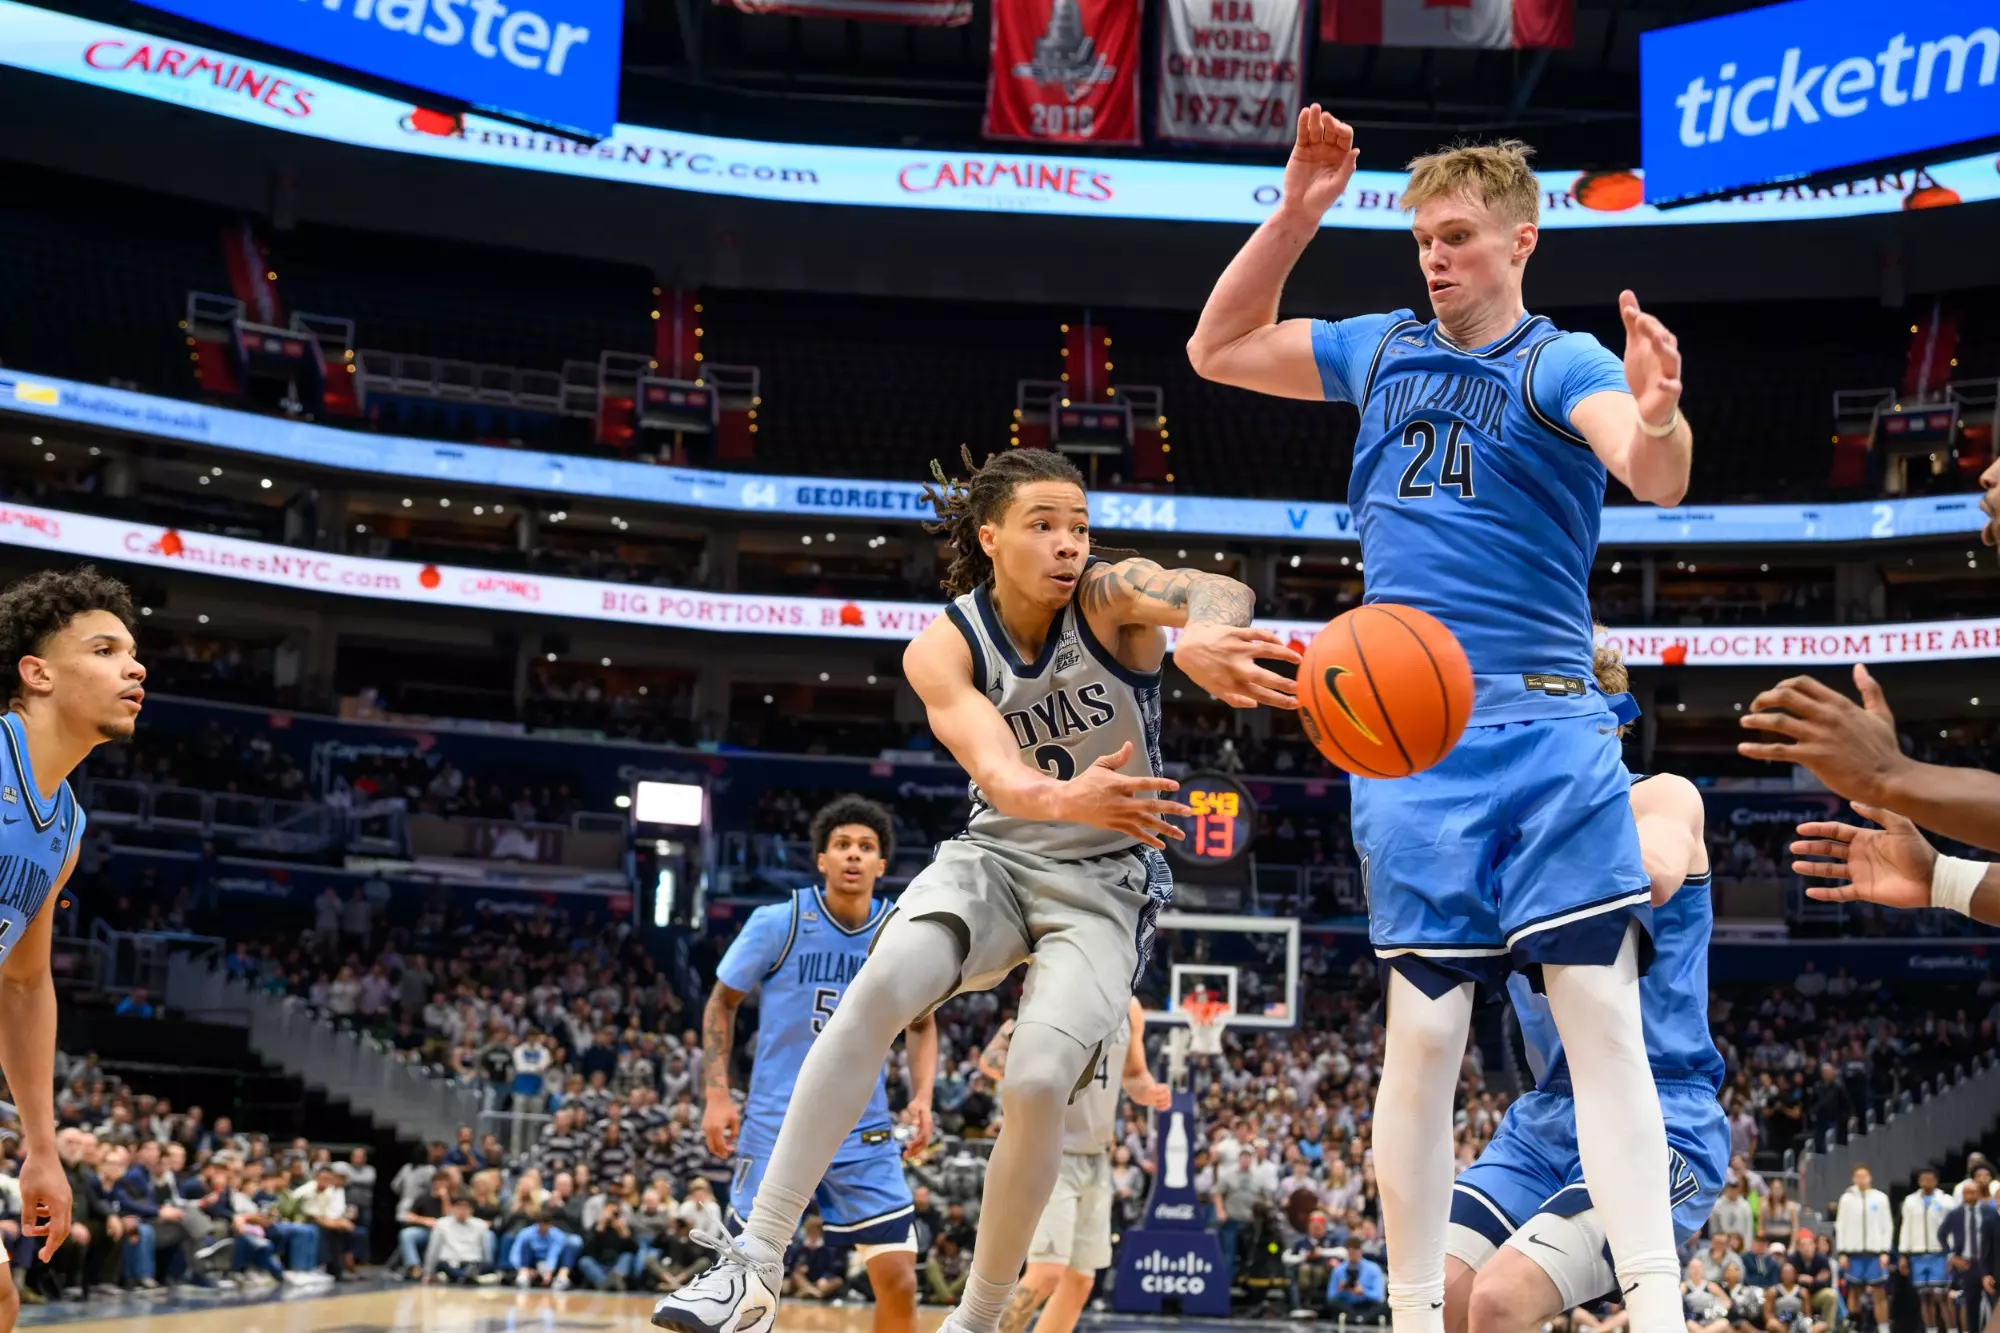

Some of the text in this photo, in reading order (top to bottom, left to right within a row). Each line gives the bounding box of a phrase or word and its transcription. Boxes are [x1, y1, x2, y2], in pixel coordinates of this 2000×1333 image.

[1210, 0, 1254, 23] NBA
[1193, 28, 1271, 52] WORLD
[84, 40, 315, 118] CARMINES
[1167, 53, 1296, 82] CHAMPIONS
[900, 160, 1114, 202] CARMINES
[1383, 373, 1509, 442] VILLANOVA
[1397, 420, 1476, 499] 24
[740, 480, 777, 508] 64
[1100, 499, 1177, 529] 5:44
[1871, 504, 1895, 537] 2
[602, 590, 648, 614] BIG
[1056, 649, 1074, 663] BIG
[1603, 635, 1665, 657] ONE
[1782, 635, 1872, 656] FROM
[1879, 630, 1943, 653] THE
[1055, 655, 1081, 671] EAST
[1194, 812, 1234, 858] 13
[811, 986, 840, 1036] 5
